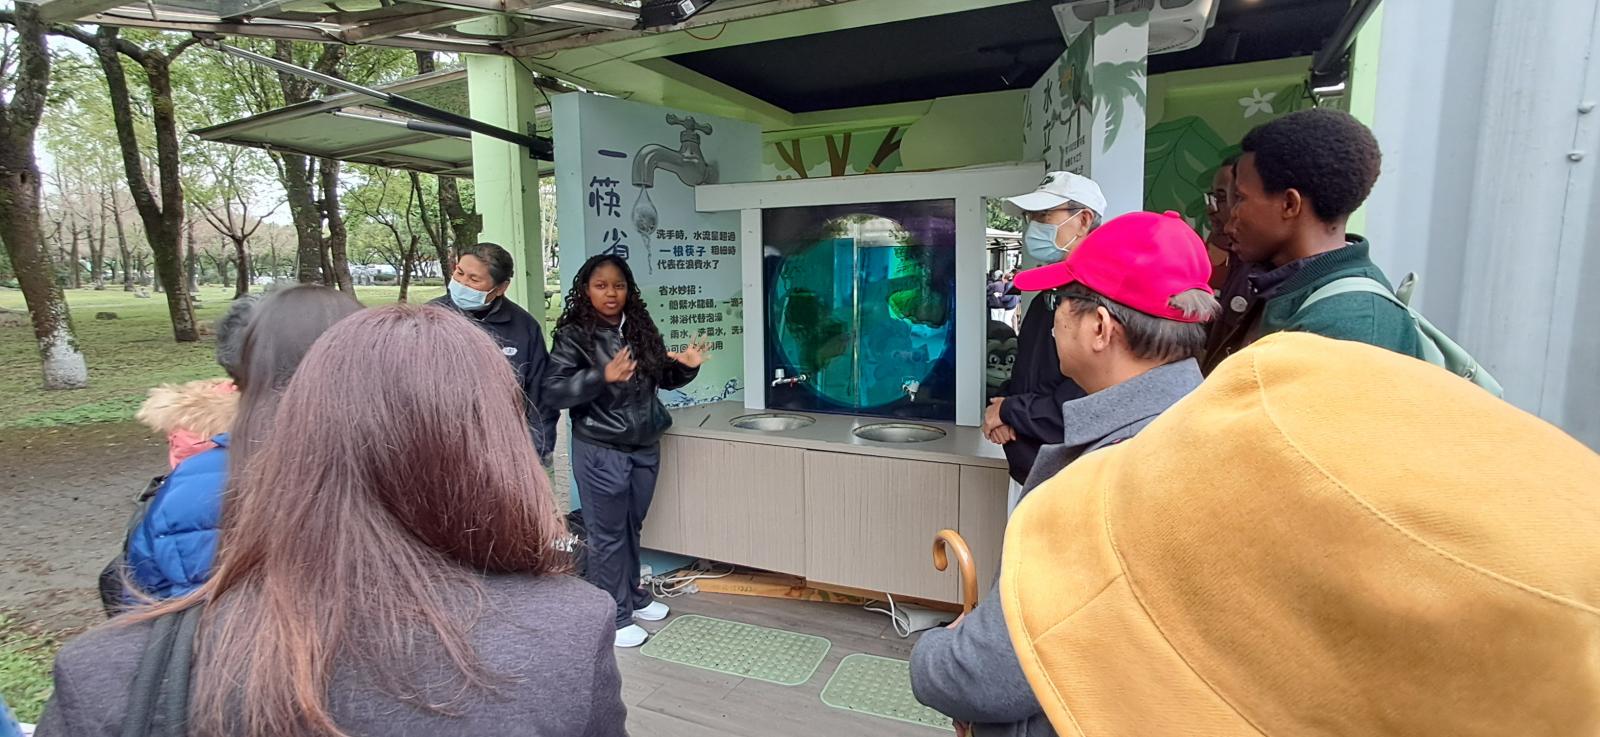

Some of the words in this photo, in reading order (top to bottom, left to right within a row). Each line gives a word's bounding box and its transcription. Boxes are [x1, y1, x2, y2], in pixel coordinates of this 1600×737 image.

[659, 245, 706, 257] 一根筷子
[657, 259, 720, 270] 代表在浪費水了
[659, 284, 702, 296] 省水妙招：
[670, 312, 723, 325] 淋浴代替泡澡
